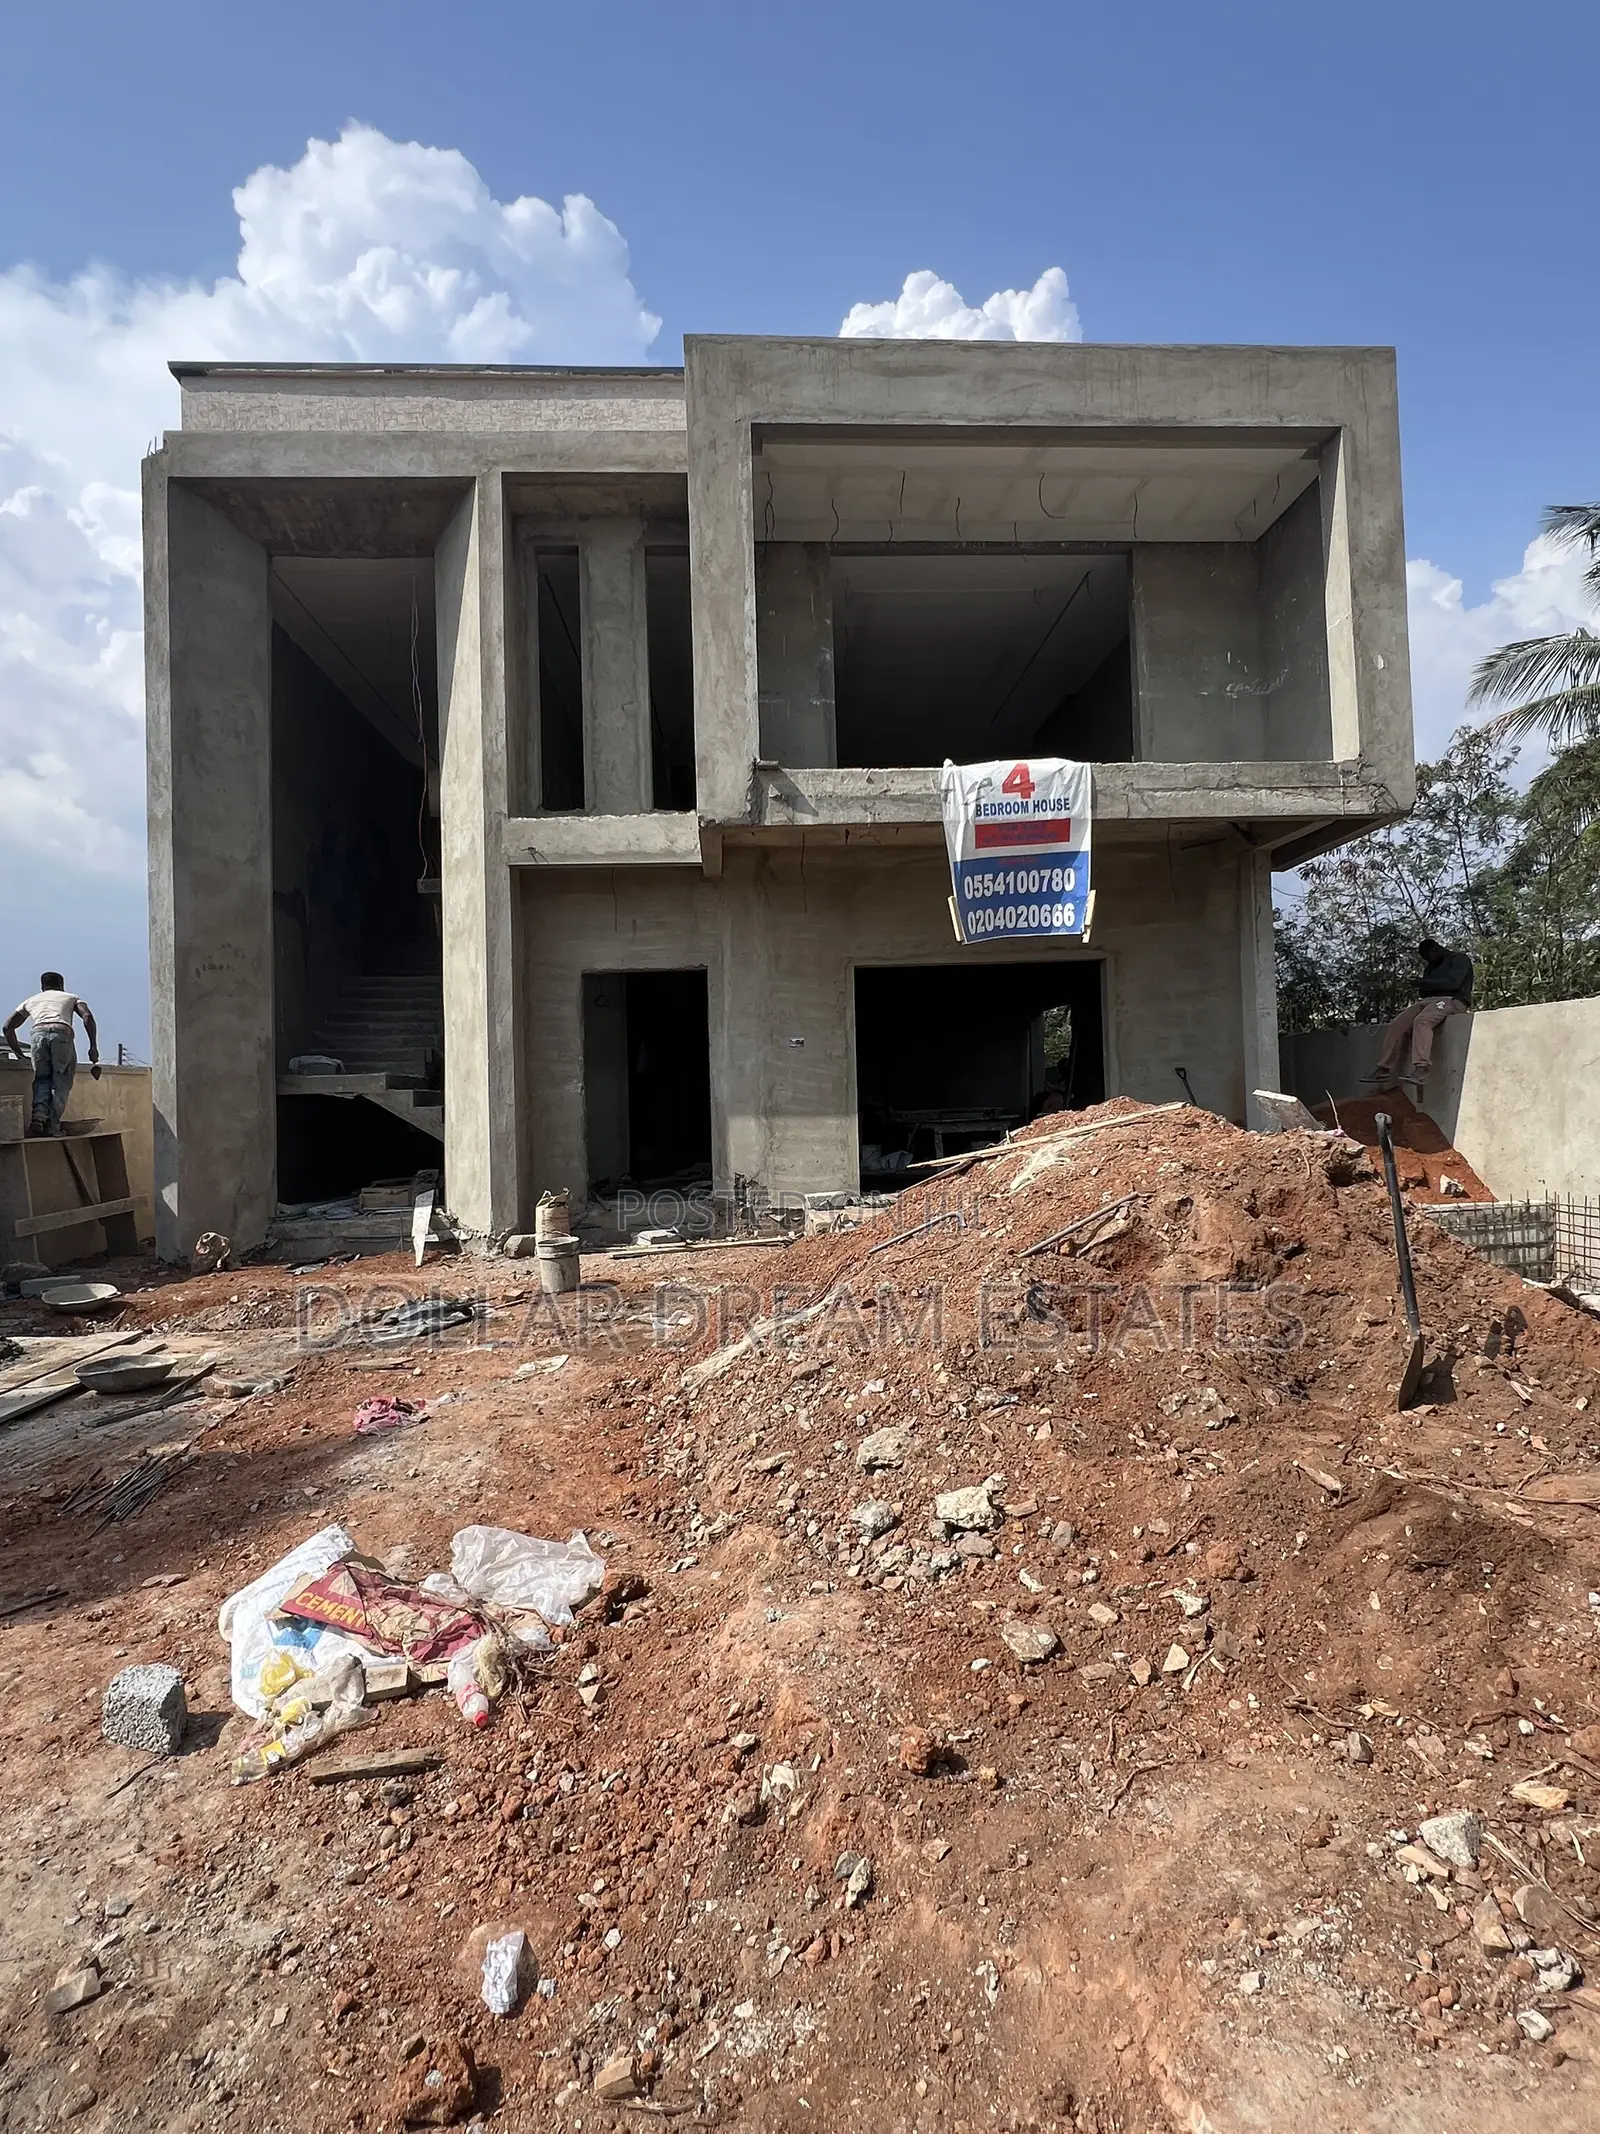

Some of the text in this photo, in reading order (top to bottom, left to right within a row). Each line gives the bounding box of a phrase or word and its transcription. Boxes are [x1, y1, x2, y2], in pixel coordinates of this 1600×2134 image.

[1001, 763, 1036, 800] 4
[975, 798, 1071, 818] BEDROOM HOUSE
[964, 868, 1076, 900] 0554100780
[967, 903, 1076, 935] 0204020666
